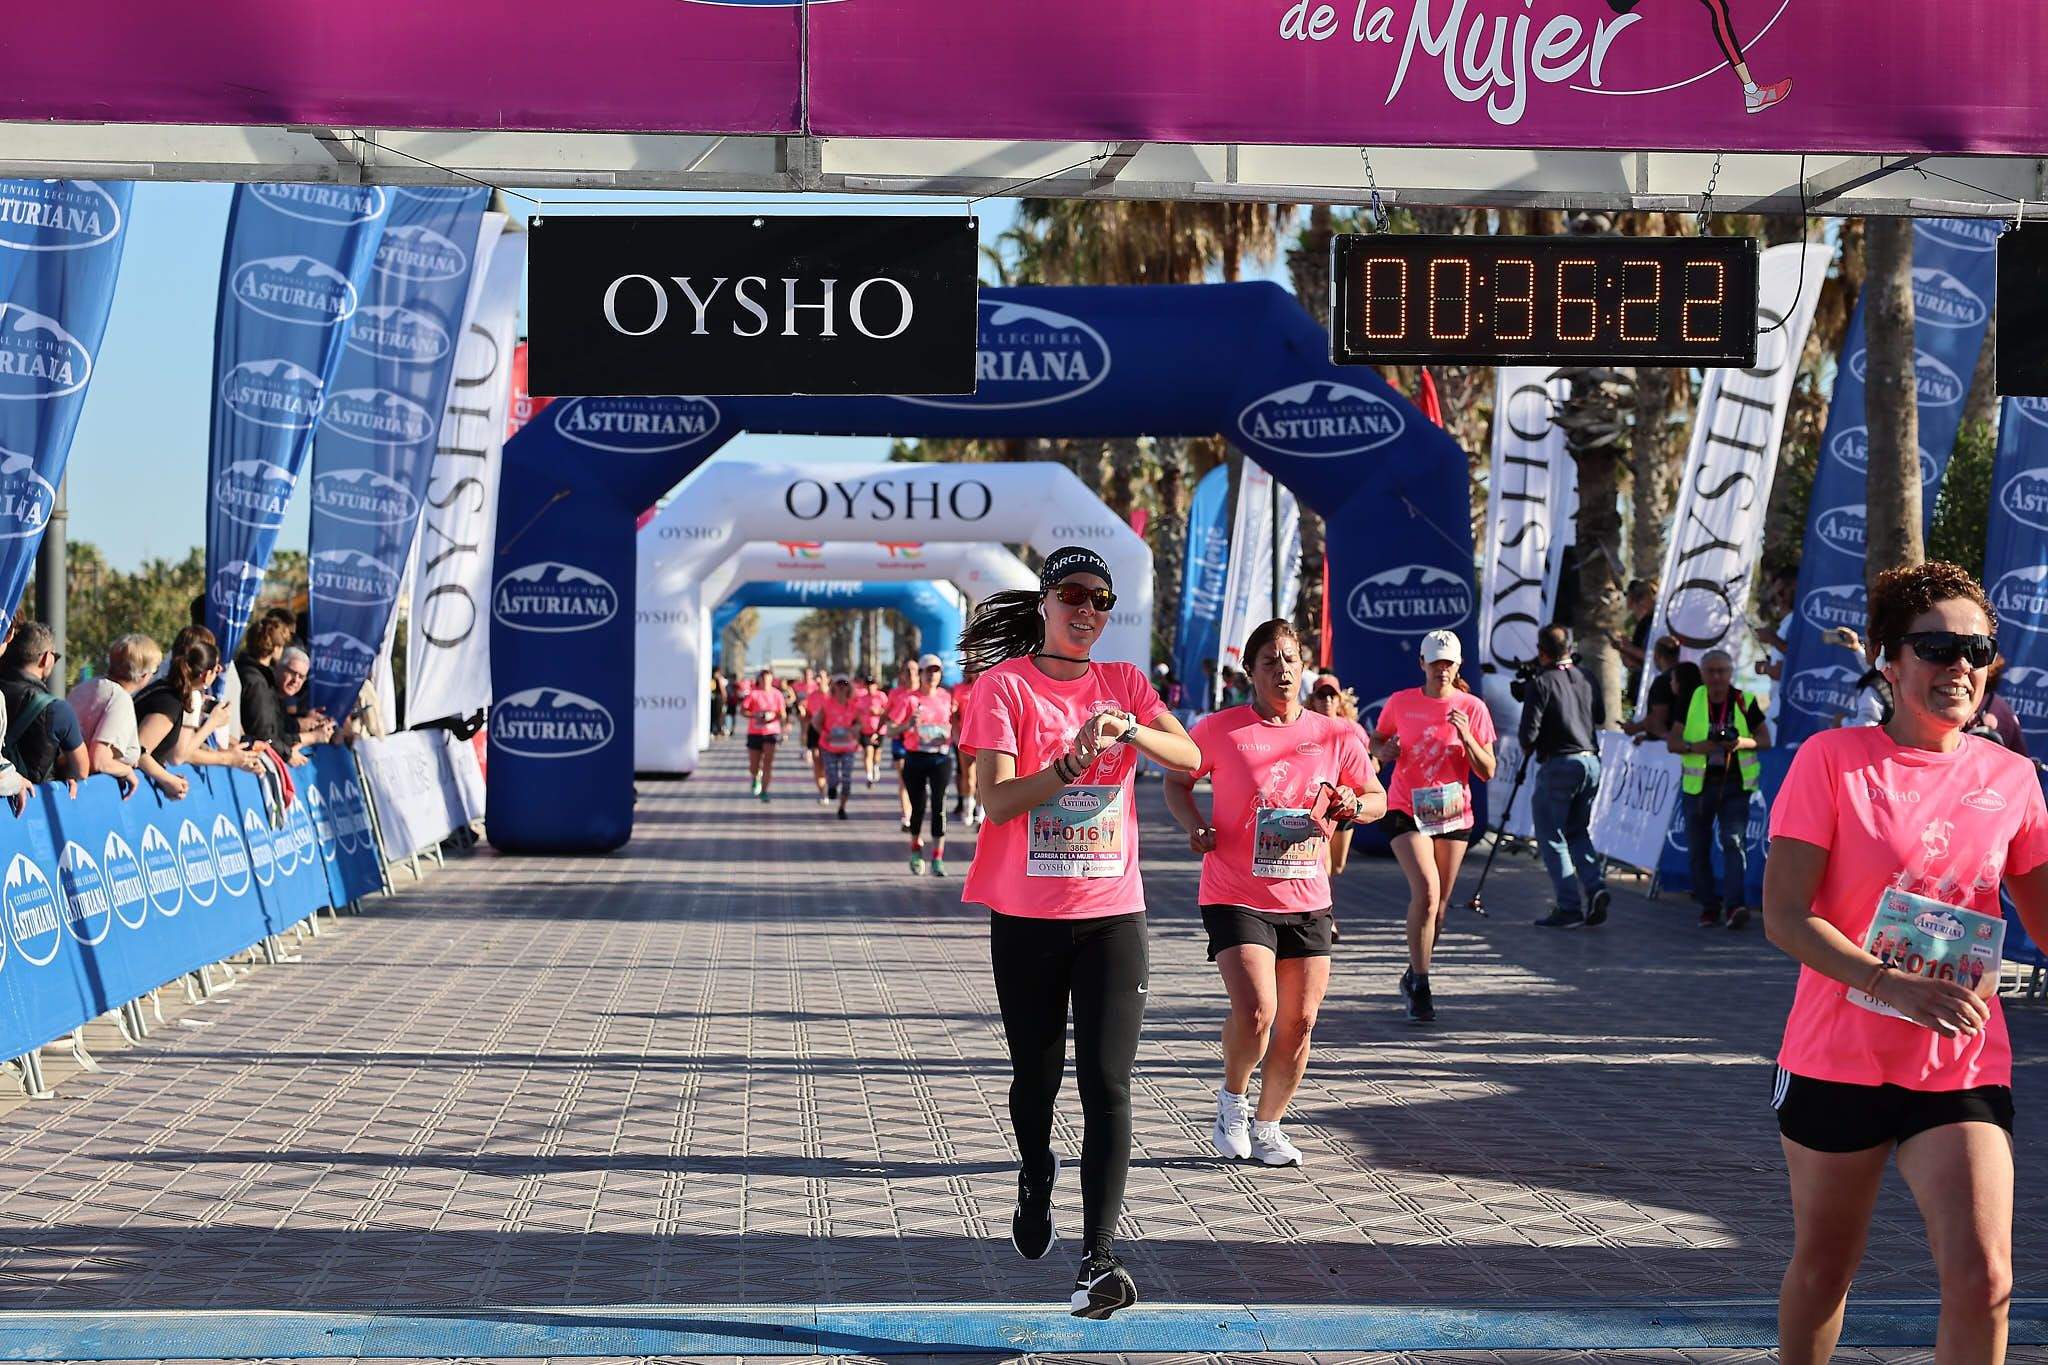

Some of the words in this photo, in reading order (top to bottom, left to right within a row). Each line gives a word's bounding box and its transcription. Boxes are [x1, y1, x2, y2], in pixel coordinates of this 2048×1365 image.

[1279, 0, 1339, 41] de
[1352, 0, 1395, 43] la
[1384, 0, 1641, 125] Mujer
[377, 246, 457, 273] STURIANA
[603, 274, 914, 339] OYSHO
[1366, 258, 1724, 342] 00:36:22
[998, 333, 1082, 344] LECHERA
[978, 350, 1091, 381] RIANA
[565, 404, 707, 434] ASTURIANA
[1252, 412, 1395, 439] ASTURIANA
[1666, 307, 1789, 649] OYSHO
[785, 479, 993, 521] OYSHO
[659, 526, 723, 540] OYSHO
[1051, 525, 1115, 539] OYSHO
[315, 573, 394, 598] STURIANA
[499, 588, 610, 616] ASTURIANA
[1356, 593, 1467, 618] ASTURIANA
[495, 712, 605, 740] ASTURIANA
[1236, 743, 1272, 752] OYSHO
[1863, 788, 1921, 803] OYSHO
[1062, 826, 1100, 841] 016
[61, 884, 109, 924] ASTURIANA
[9, 899, 58, 941] ASTURIANA
[1906, 954, 1954, 981] 016
